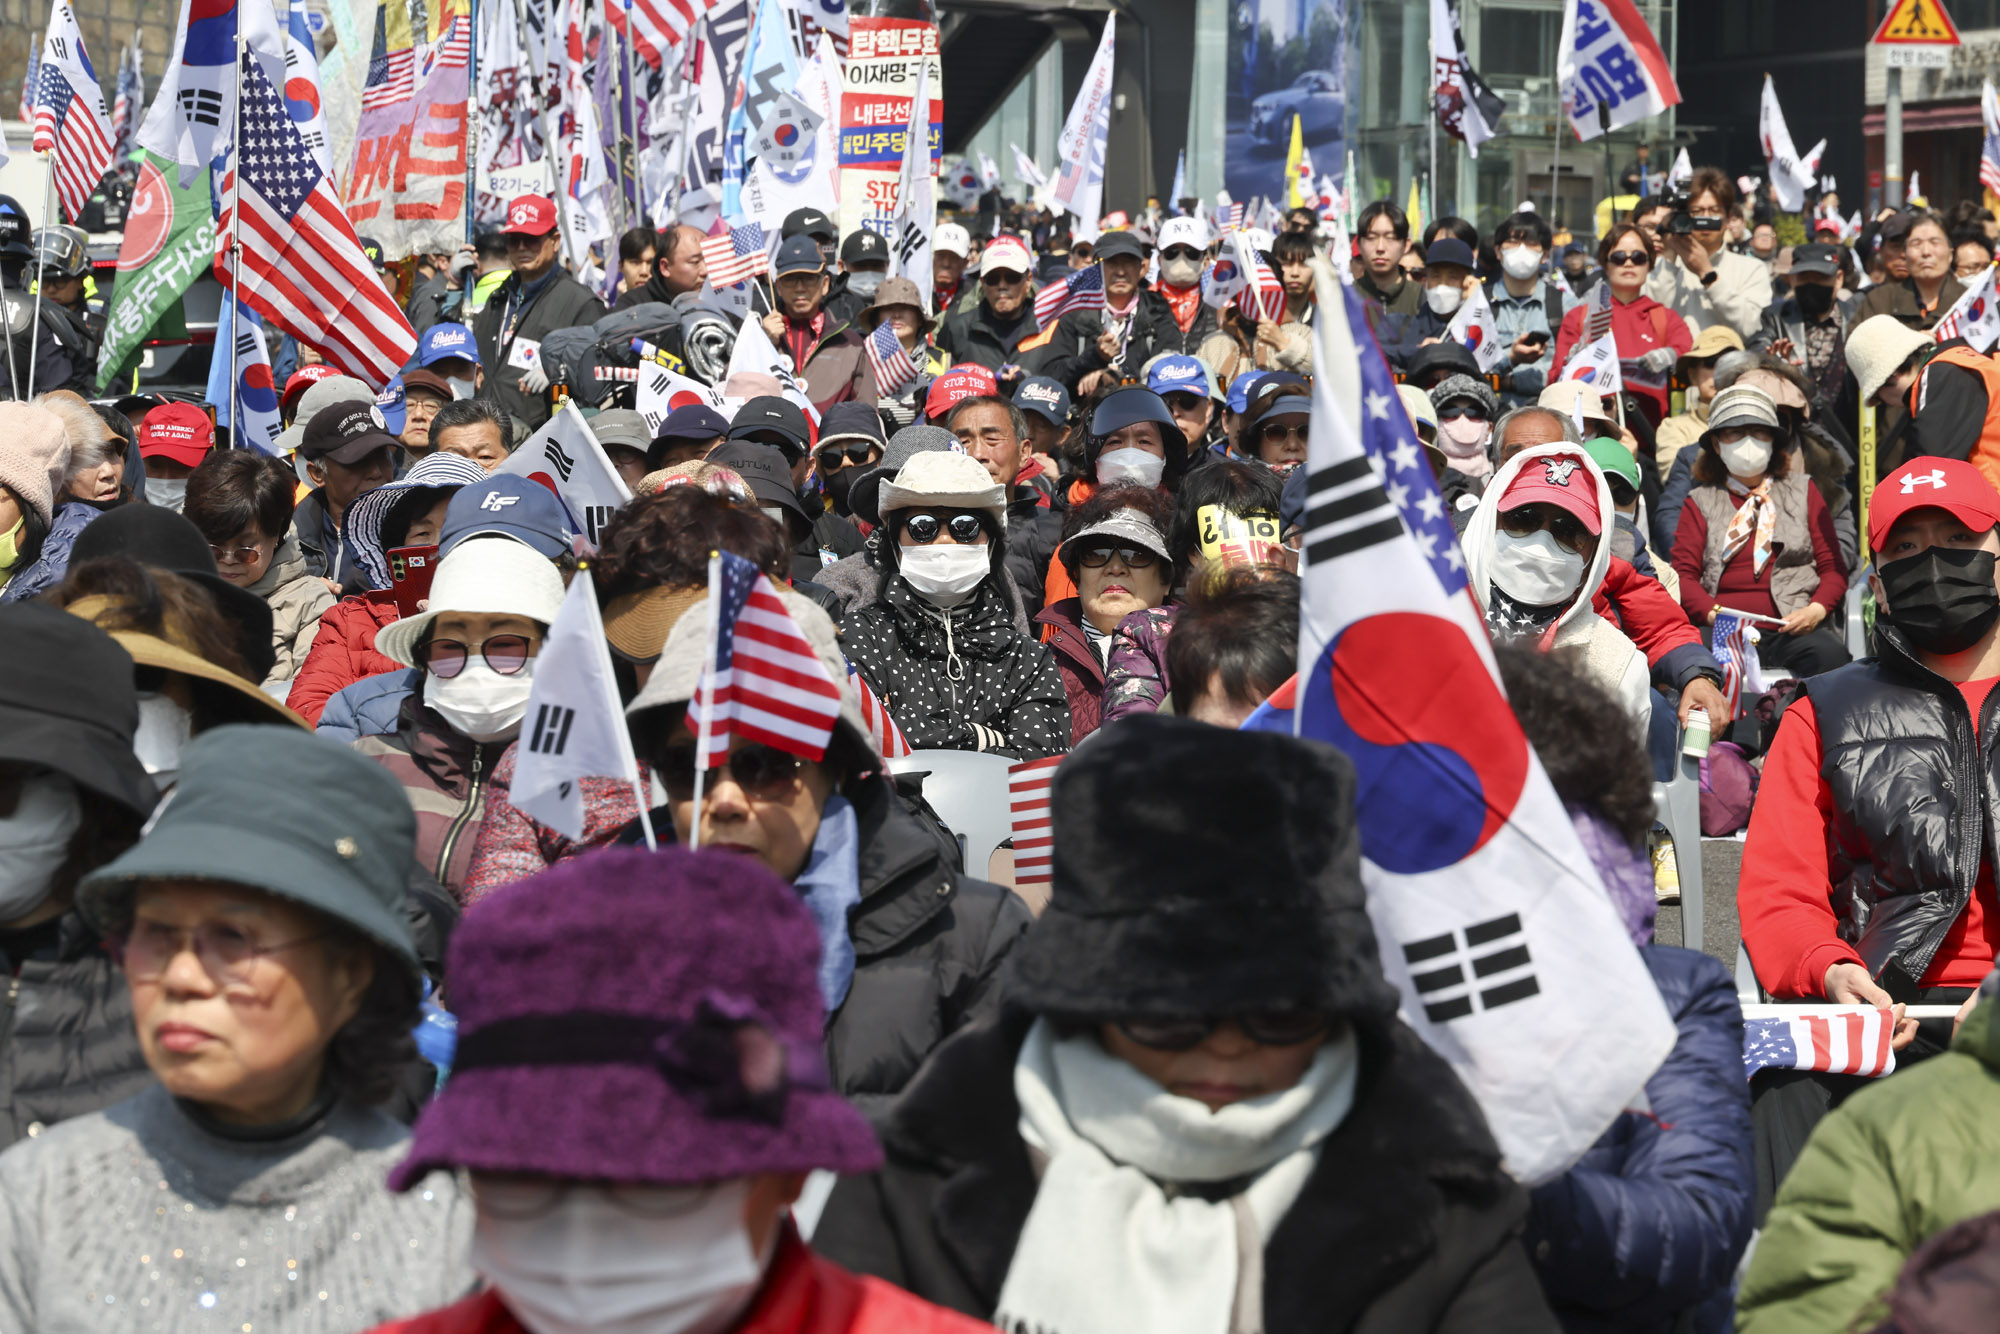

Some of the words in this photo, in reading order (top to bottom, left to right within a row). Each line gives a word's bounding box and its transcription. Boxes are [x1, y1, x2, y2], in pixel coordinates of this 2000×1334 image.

[852, 27, 938, 58] 탄핵무효
[854, 101, 912, 125] 내란선
[853, 129, 940, 155] 민주당산
[866, 180, 900, 200] STO
[873, 200, 897, 219] TH
[943, 376, 966, 389] STOP
[967, 376, 986, 390] THE
[166, 424, 196, 434] AMERICA
[171, 432, 192, 440] AGAIN
